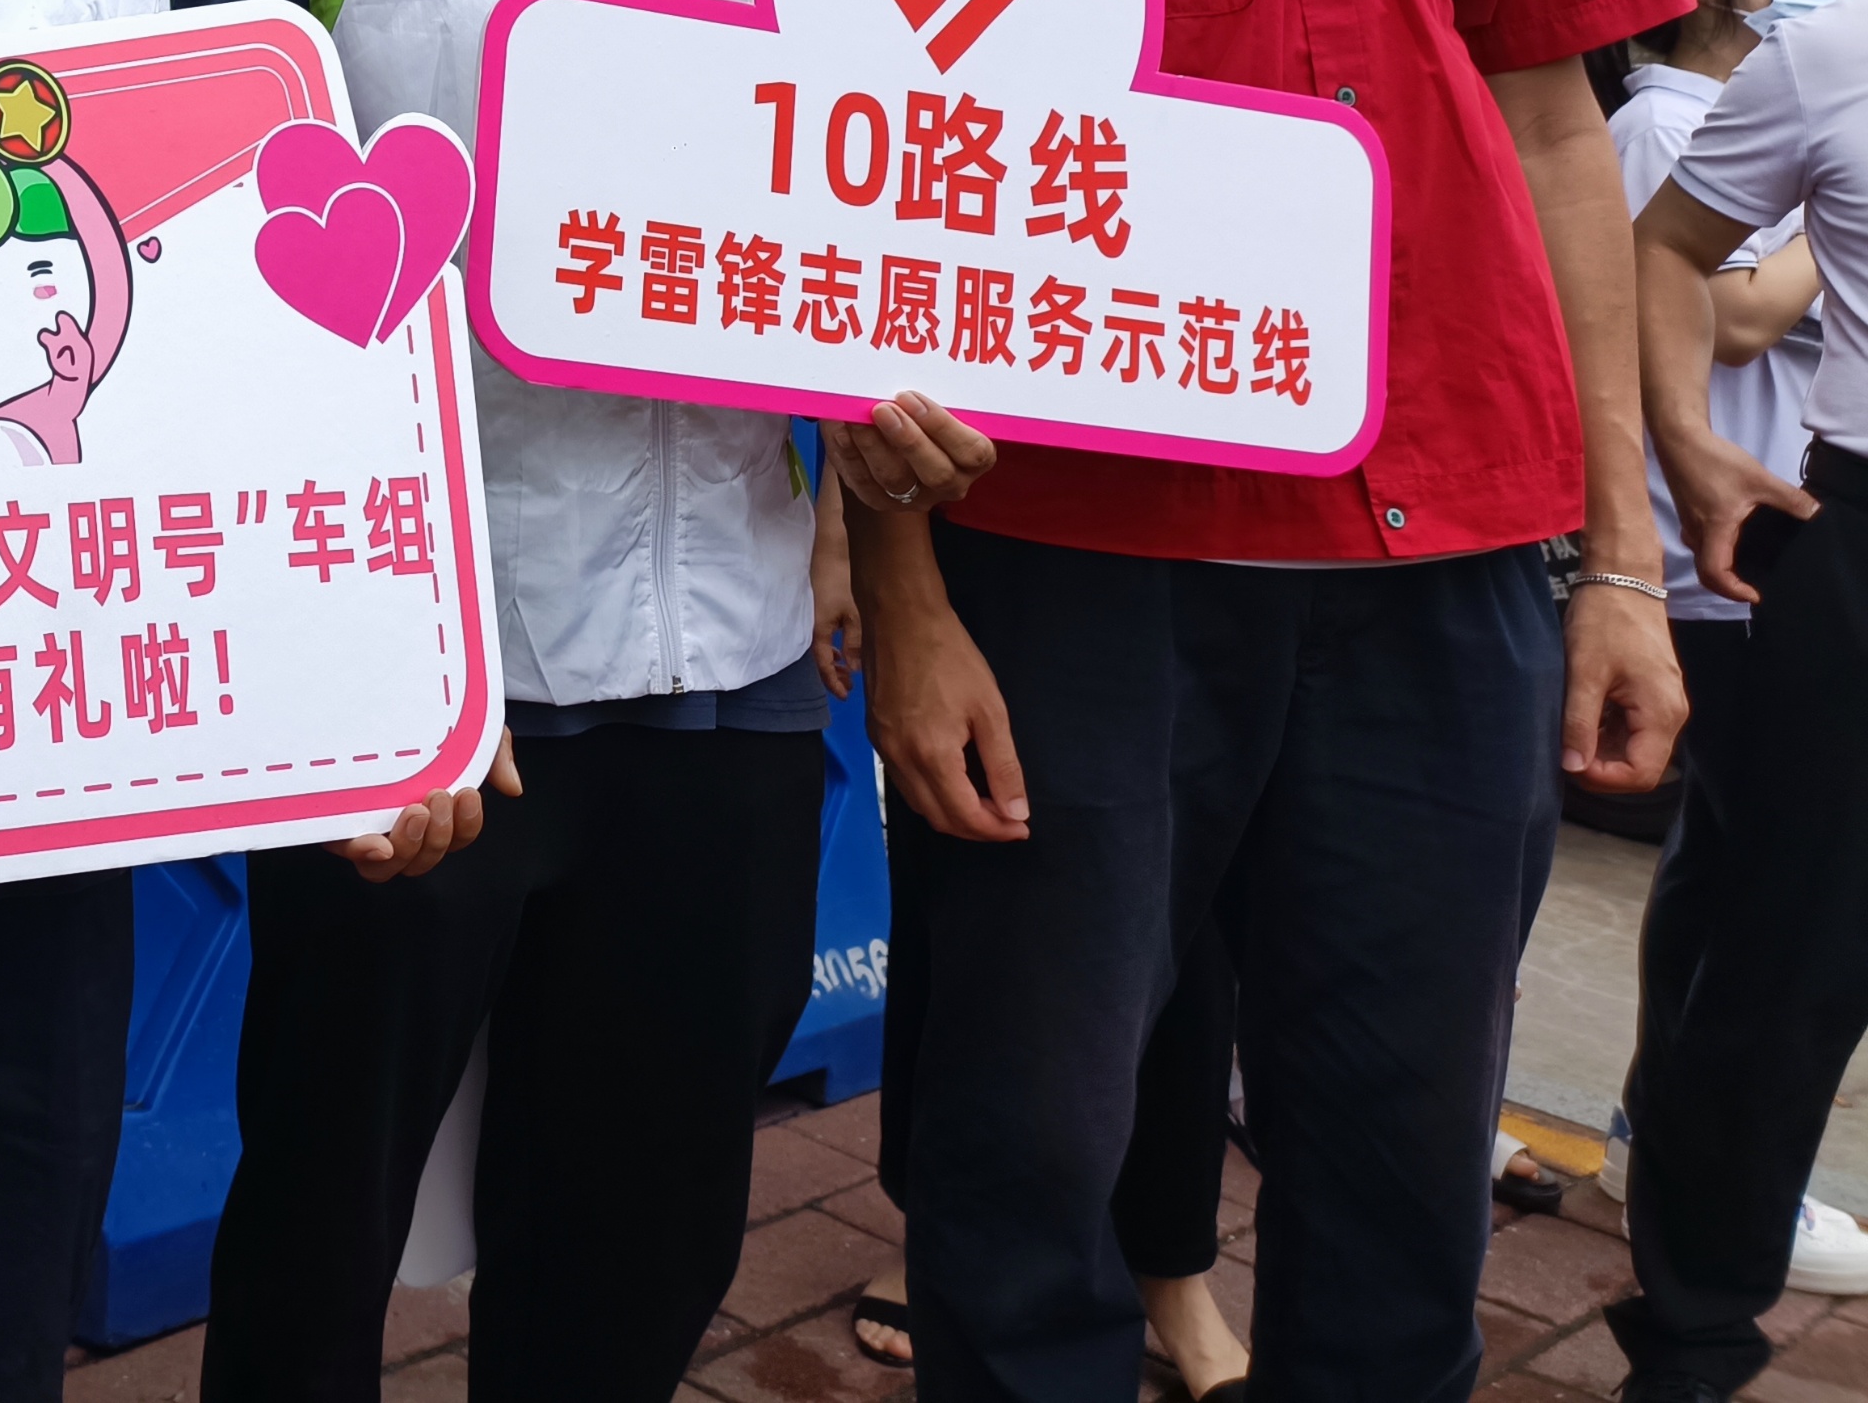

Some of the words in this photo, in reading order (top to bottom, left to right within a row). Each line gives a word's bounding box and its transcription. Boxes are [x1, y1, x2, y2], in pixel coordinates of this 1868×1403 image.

[753, 81, 1132, 260] 10路线
[554, 208, 1313, 408] 学雷锋志愿服务示范线
